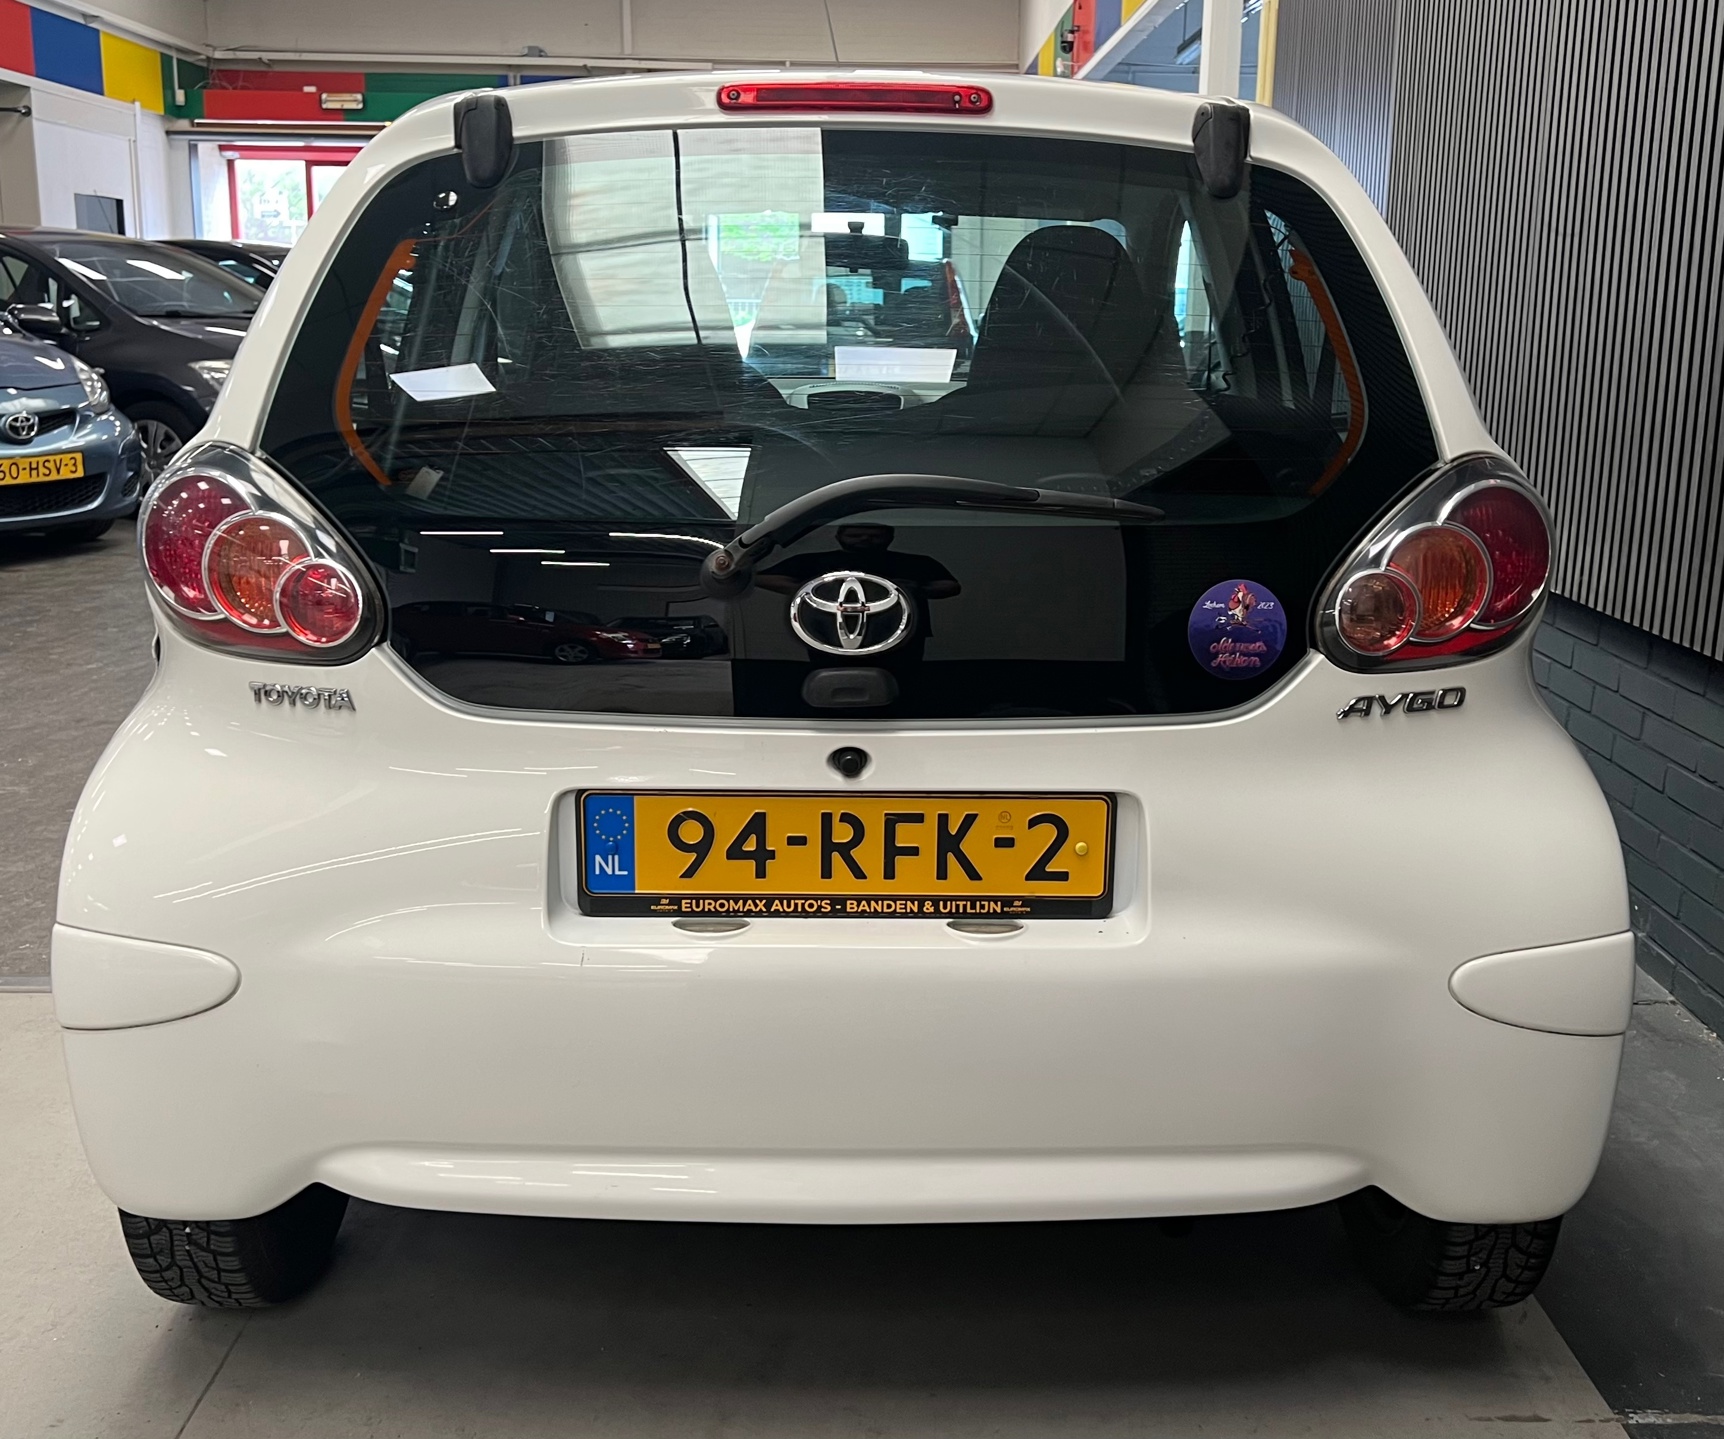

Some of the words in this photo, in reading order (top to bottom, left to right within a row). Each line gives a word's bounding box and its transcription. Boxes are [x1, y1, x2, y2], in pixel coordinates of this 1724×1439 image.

[248, 680, 357, 712] TOYOTA
[1336, 685, 1467, 720] AYGO
[667, 809, 1070, 882] 94-RFK-2
[594, 854, 629, 875] NL
[681, 899, 767, 912] EUROMAX
[770, 899, 832, 912] AUTO'S
[846, 900, 918, 913] BANDEN
[923, 900, 935, 913] &
[939, 900, 1001, 914] UITLIJN
